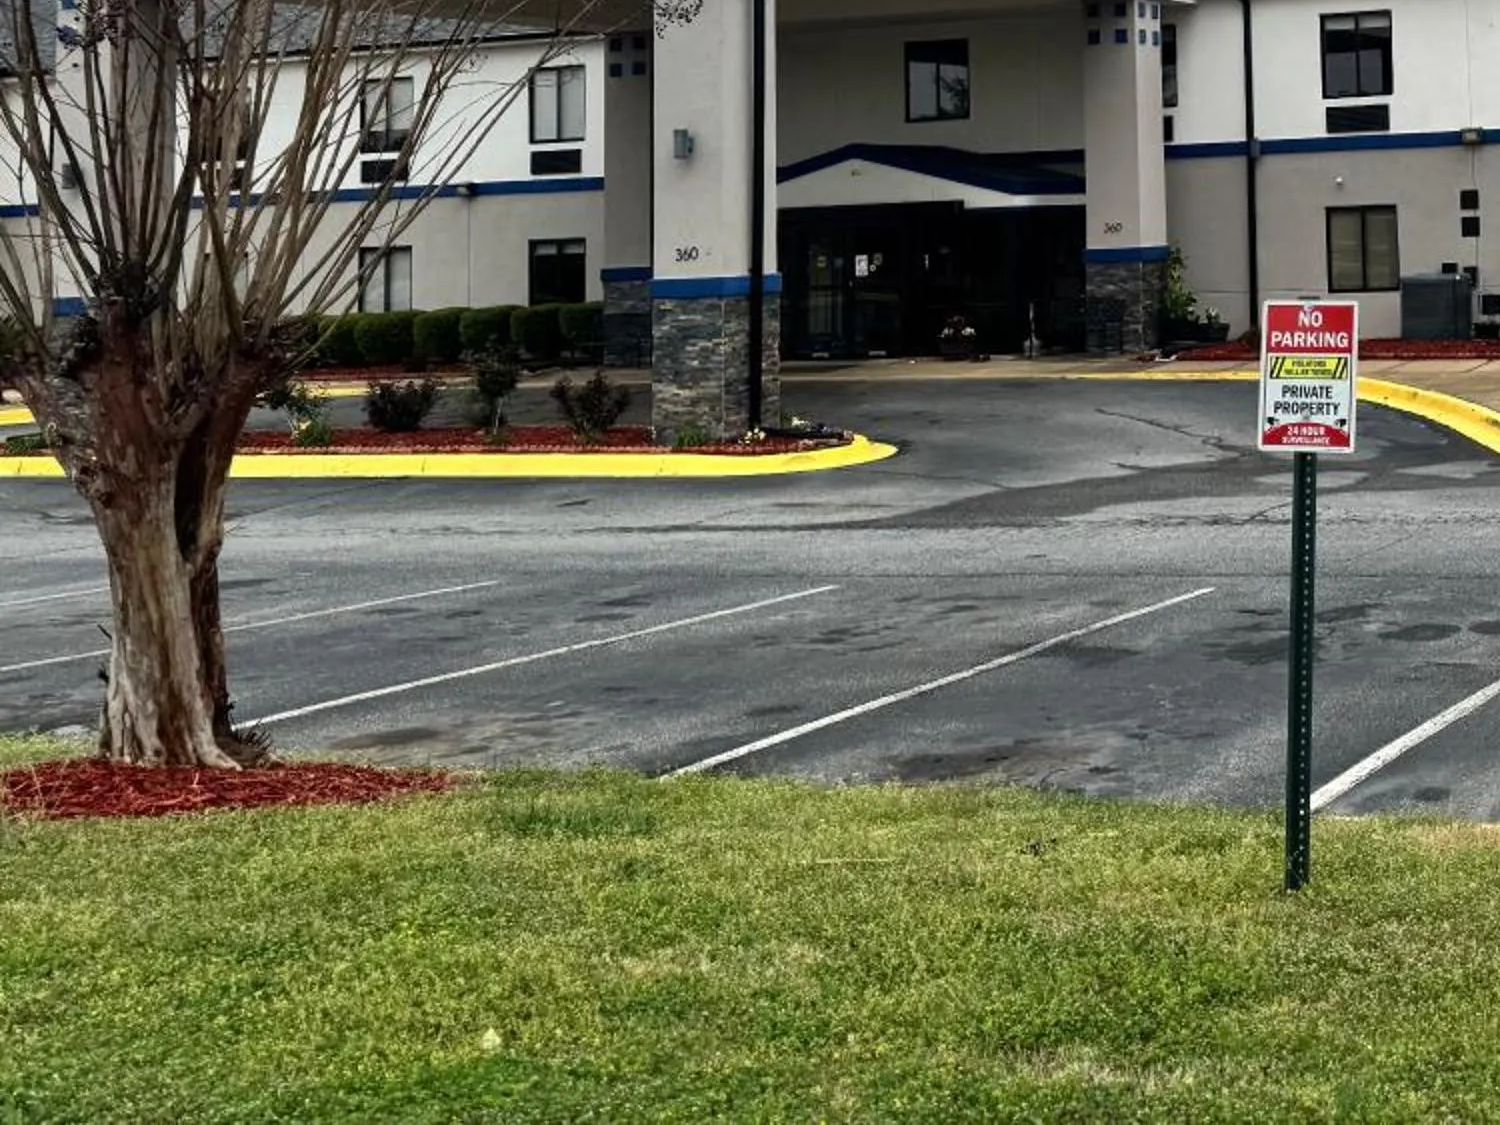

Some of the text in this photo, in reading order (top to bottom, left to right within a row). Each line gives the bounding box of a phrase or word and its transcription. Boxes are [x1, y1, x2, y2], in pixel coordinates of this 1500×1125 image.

[675, 246, 699, 262] 360
[1297, 310, 1323, 328] NO
[1271, 331, 1349, 348] PARKING
[1281, 384, 1333, 400] PRIVATE
[1273, 400, 1341, 416] PROPERTY
[1287, 426, 1299, 436] 24
